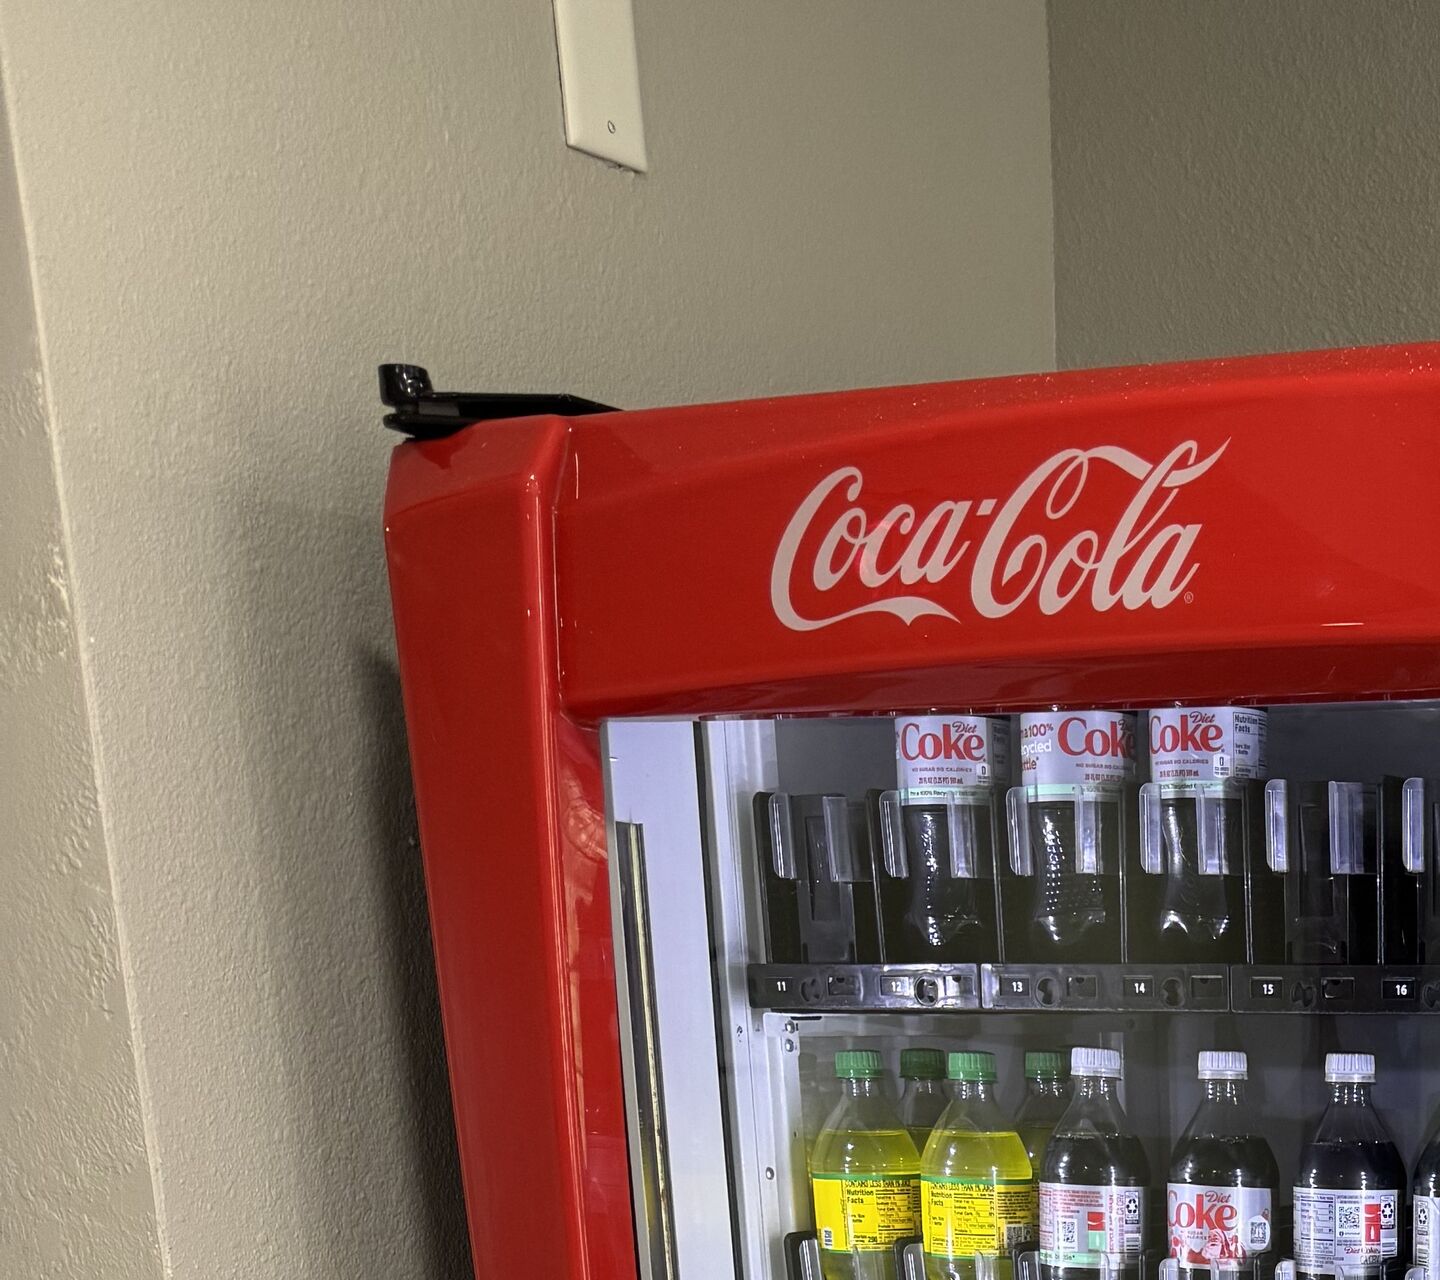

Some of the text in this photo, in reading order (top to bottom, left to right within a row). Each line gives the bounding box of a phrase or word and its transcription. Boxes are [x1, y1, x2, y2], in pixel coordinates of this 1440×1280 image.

[770, 436, 1232, 632] Coca-Cola
[1190, 711, 1215, 723] Diet
[952, 721, 977, 734] Diet
[1150, 715, 1224, 755] Coke
[901, 723, 984, 761] Coke
[776, 981, 787, 991] 11
[891, 981, 902, 992] 12
[1012, 982, 1023, 992] 13
[1134, 982, 1146, 993] 14
[1262, 984, 1274, 995] 15
[1395, 984, 1408, 996] 16
[1204, 1190, 1232, 1204] Diet
[1167, 1190, 1238, 1232] Coke
